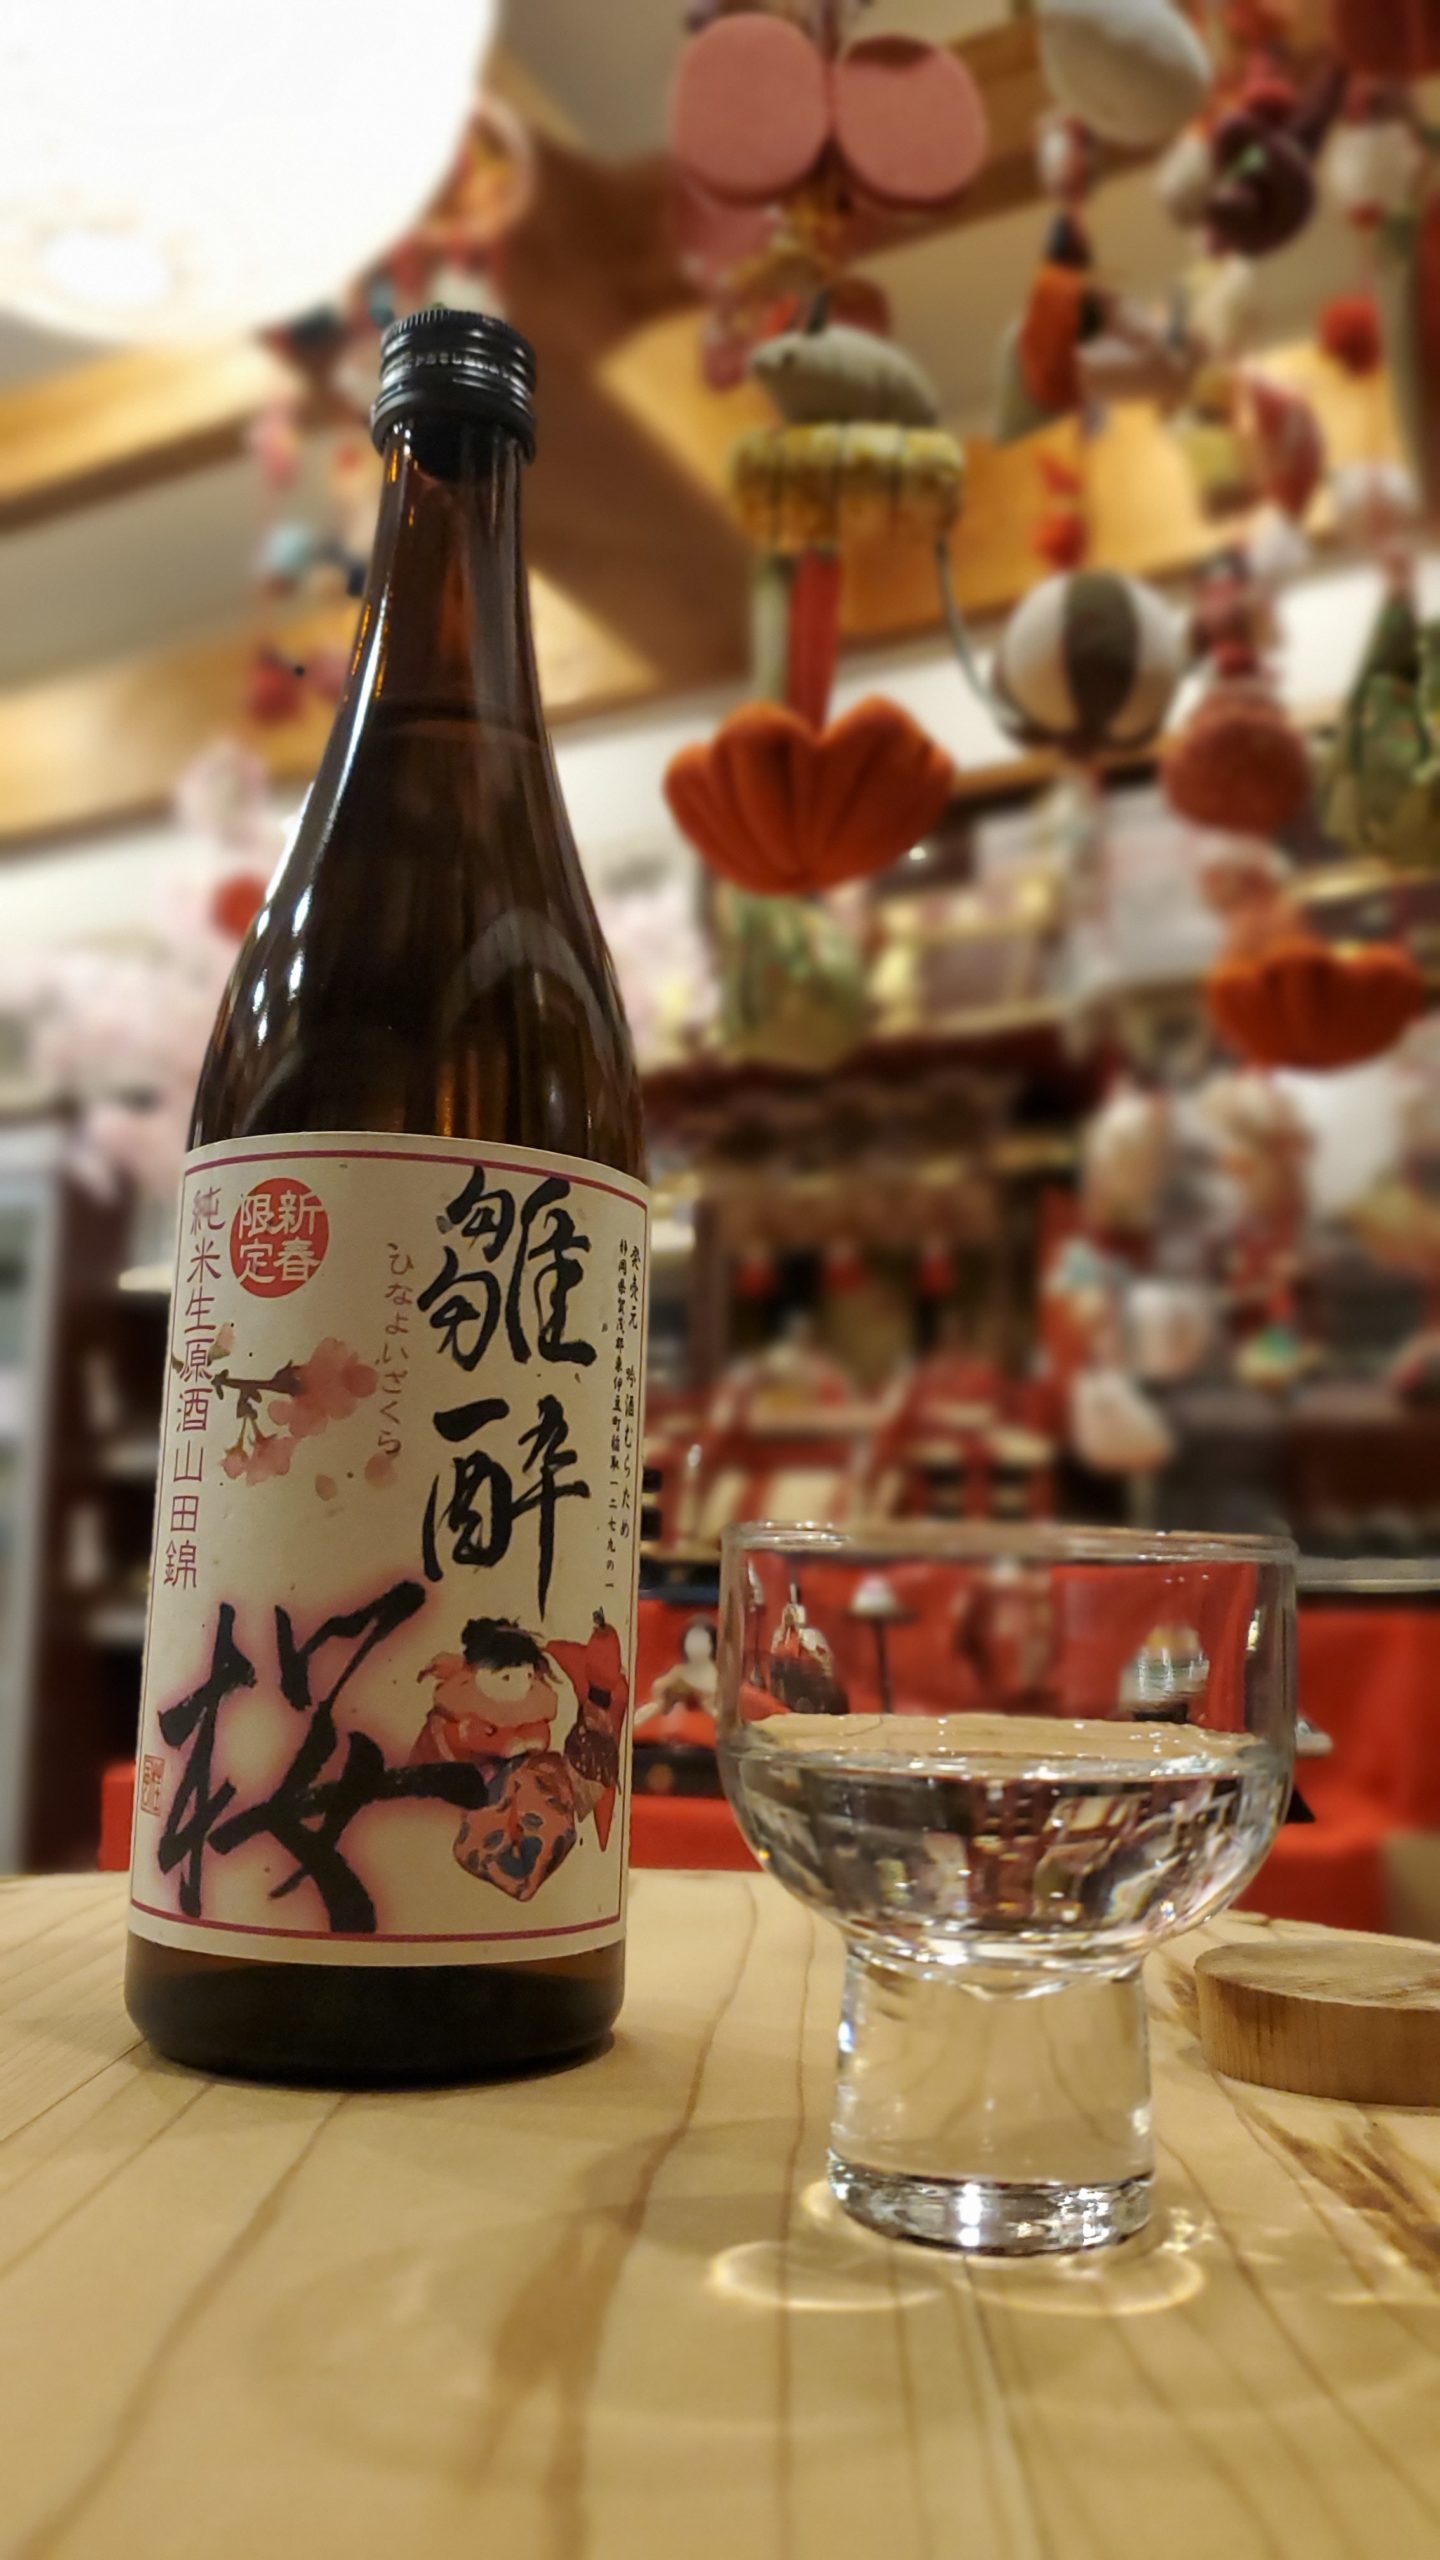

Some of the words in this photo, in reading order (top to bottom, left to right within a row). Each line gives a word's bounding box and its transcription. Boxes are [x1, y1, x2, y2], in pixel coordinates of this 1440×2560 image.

[239, 1193, 285, 1284] 限定
[273, 1190, 325, 1281] 新春
[163, 1186, 225, 1589] 純米生原酒山田錦
[376, 1242, 415, 1457] ひなよいざくら
